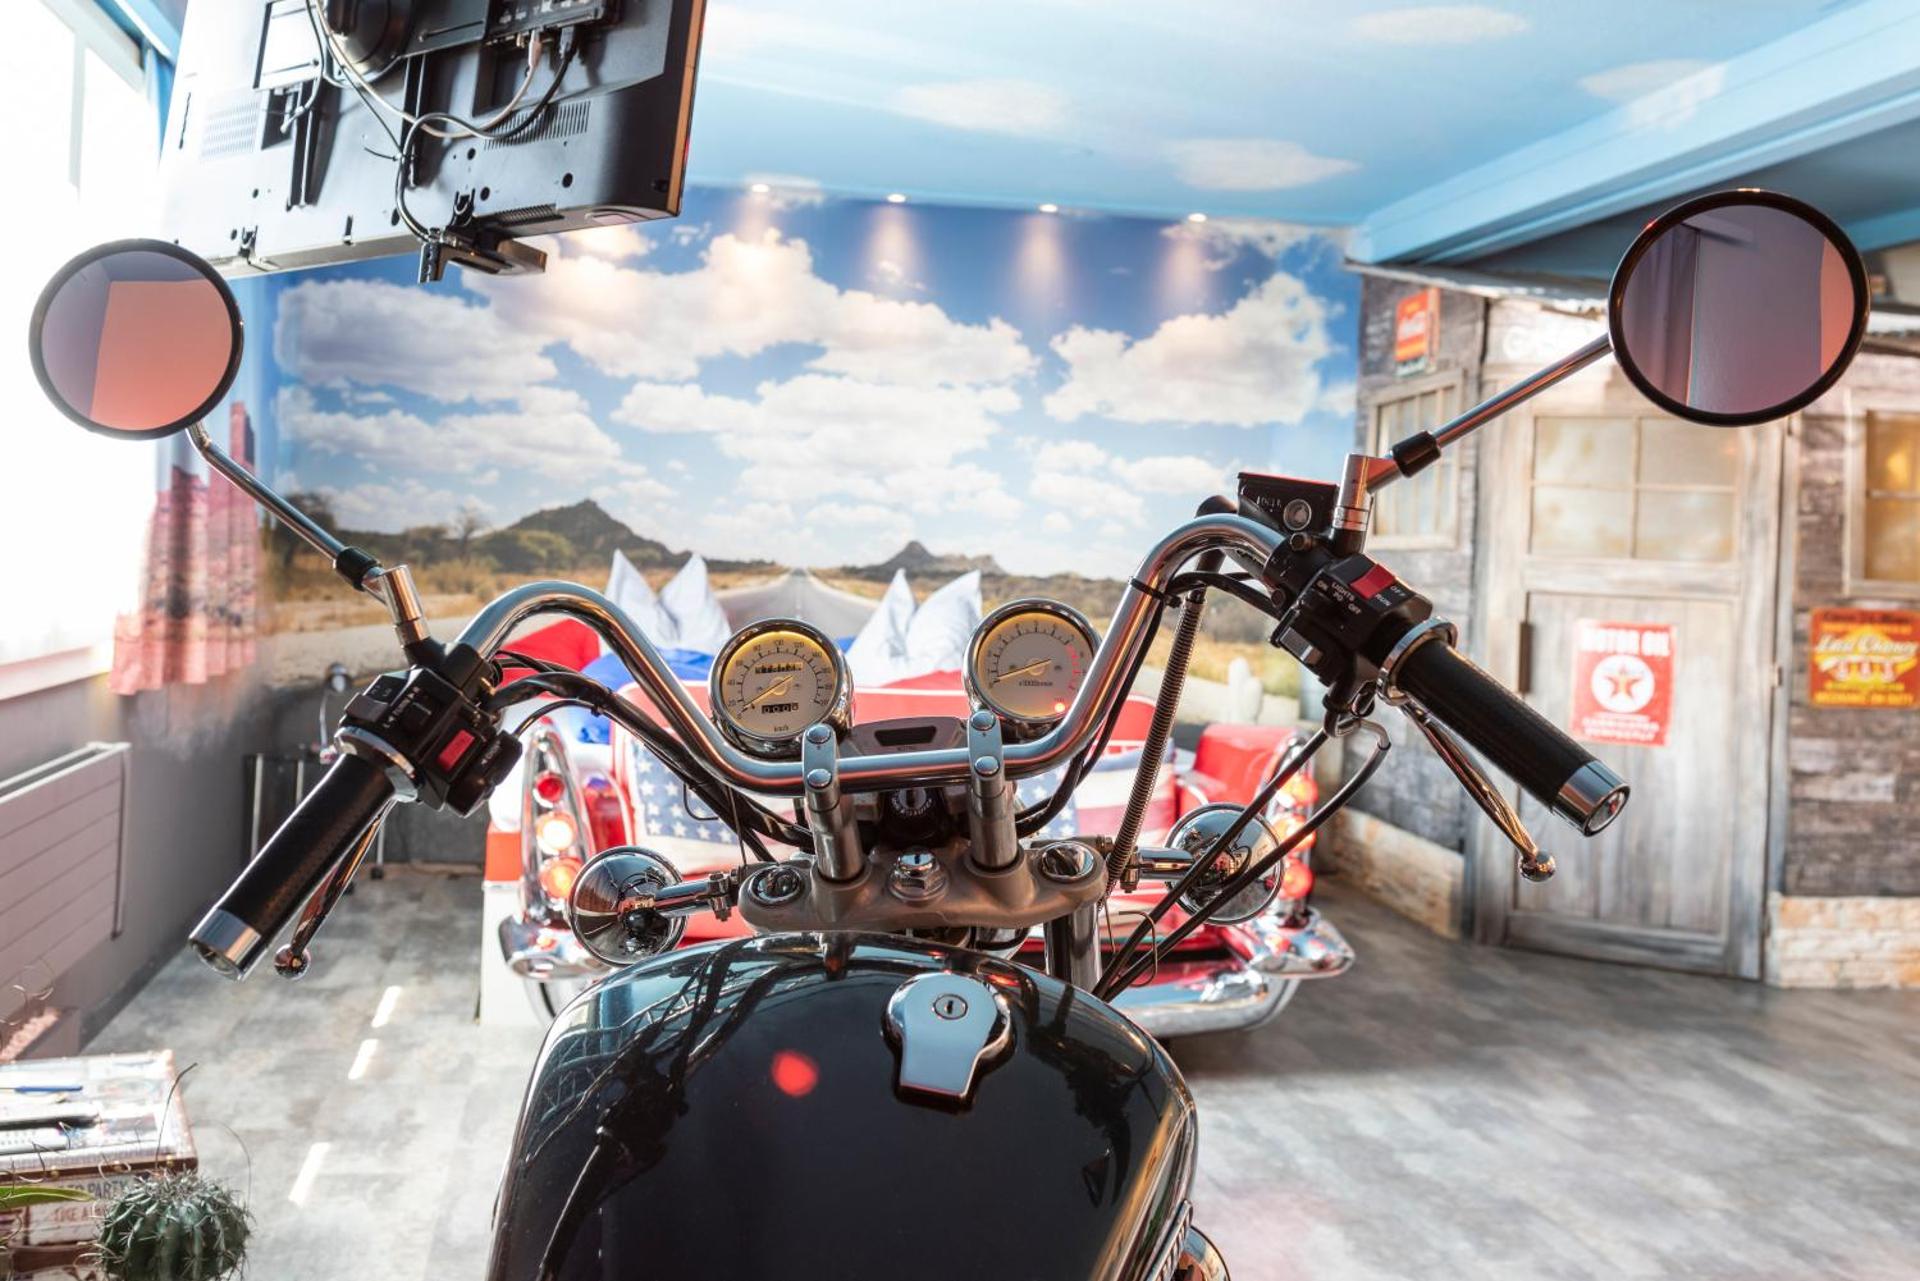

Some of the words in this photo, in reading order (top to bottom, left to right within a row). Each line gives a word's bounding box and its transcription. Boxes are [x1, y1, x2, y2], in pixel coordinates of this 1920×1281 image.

[1331, 582, 1355, 601] LIGHTS
[1390, 585, 1406, 597] OFF
[1374, 593, 1393, 607] RUN
[1347, 603, 1362, 615] OFF
[1641, 631, 1671, 656] OIL
